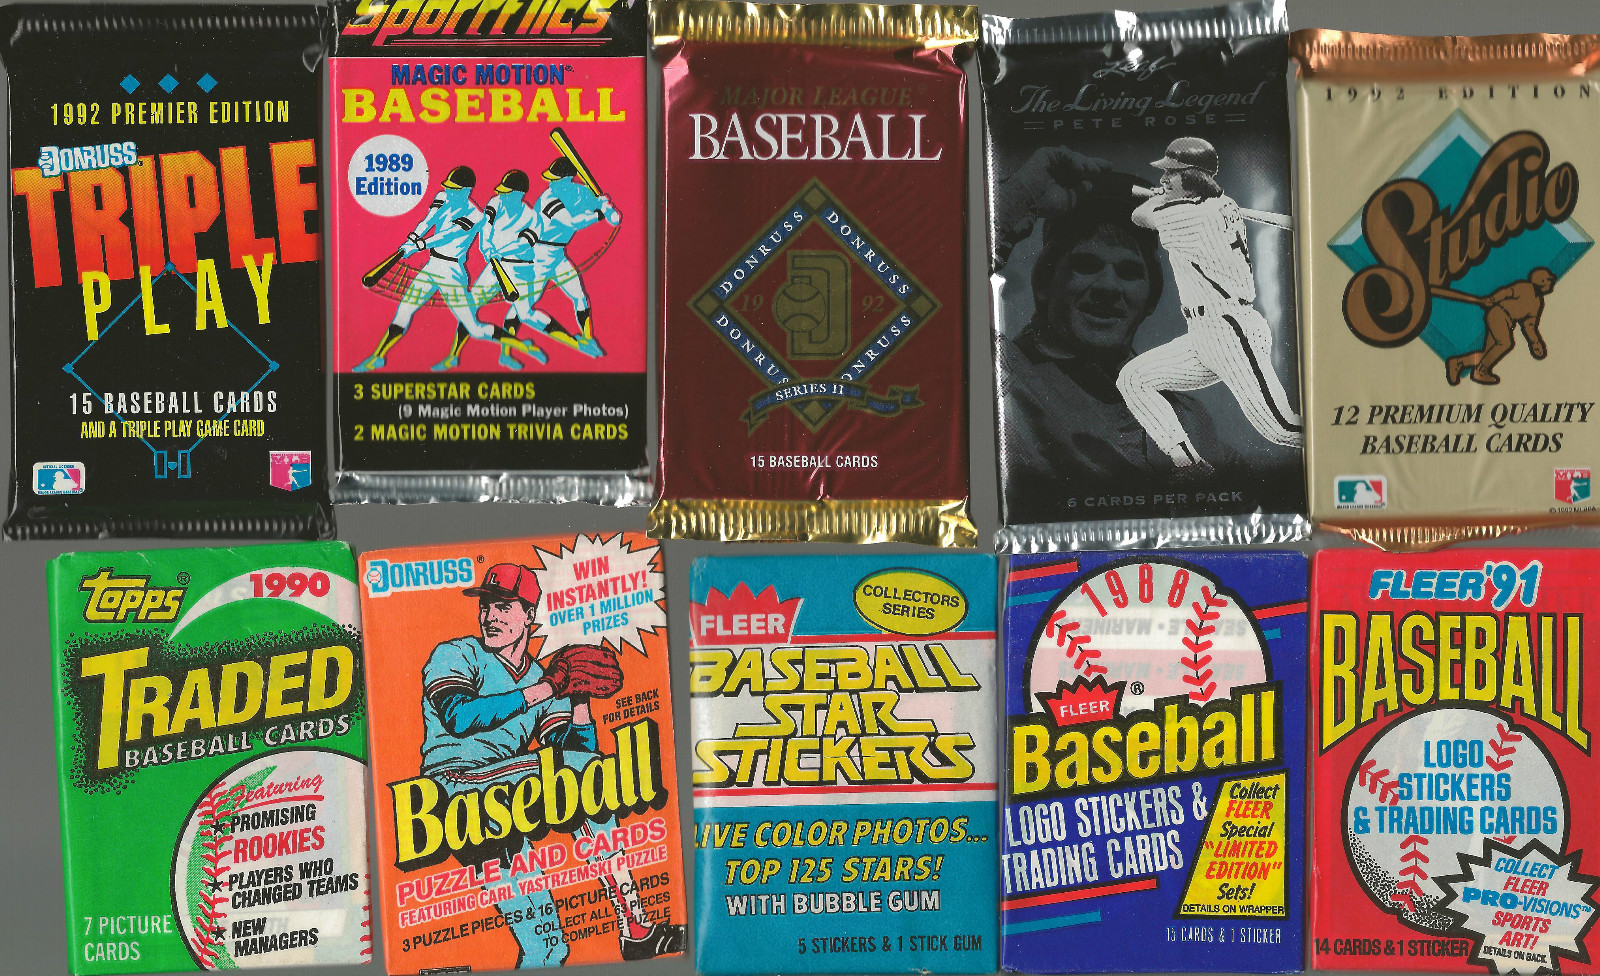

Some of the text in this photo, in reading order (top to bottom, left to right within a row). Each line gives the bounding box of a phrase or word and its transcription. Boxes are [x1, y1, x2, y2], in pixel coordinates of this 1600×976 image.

[391, 63, 467, 86] MAGIC
[341, 87, 626, 123] BASEBALL
[720, 85, 912, 108] MAJOR LEAGUE
[1011, 79, 1271, 118] The Living Legend
[1326, 84, 1592, 101] 1992 EDITION
[51, 100, 290, 126] 1992 PREMIER EDITION
[1053, 114, 1218, 130] PETE ROSE
[688, 112, 943, 161] BASEBALL
[365, 153, 414, 173] 1989
[355, 176, 422, 196] Edition
[11, 139, 321, 288] TRIPLE
[1343, 131, 1577, 347] Studio
[719, 211, 804, 296] DONRUSS
[826, 211, 910, 296] DONRUSS
[82, 253, 274, 341] PLAY
[69, 390, 278, 415] 15 BASEBALL CARDS
[371, 381, 536, 400] SUPERSTAR CARDS
[775, 383, 827, 401] SERIES
[418, 402, 629, 420] Magic Motion Player Photos)
[1331, 402, 1595, 428] 12 PREMIUM QUALITY
[80, 419, 265, 439] AND TRIPLE PLAY GAME CARD
[354, 422, 629, 441] 2 MAGIC MOTION TRIVIA CARDS
[1360, 432, 1564, 456] BASEBALL CARDS
[750, 455, 878, 468] 15 BASEBALL CARDS
[1084, 491, 1244, 507] CARDS PER PACK
[367, 557, 473, 593] DONRUSS
[573, 555, 610, 581] WIN
[250, 571, 331, 598] 1990
[546, 570, 647, 612] INSTANTLY!
[862, 584, 960, 608] COLLECTORS
[1081, 564, 1190, 617] 1988
[549, 589, 654, 628] OVER MILLION
[882, 602, 936, 621] SERIES
[583, 612, 629, 636] PRIZES
[701, 613, 786, 637] FLEER
[689, 645, 981, 697] BASEBALL
[1319, 611, 1591, 755] BASEBALL
[81, 646, 354, 770] TRADED
[615, 688, 659, 709] SEE BACK
[1060, 700, 1110, 718] FLEER
[603, 701, 660, 725] FOR DETAILS
[734, 691, 939, 737] STAR
[124, 714, 351, 769] BASEBALL CARDS
[1012, 690, 1275, 796] Baseball
[1424, 739, 1484, 769] LOGO
[693, 733, 976, 788] STICKERS
[388, 719, 664, 868] Baseball
[1229, 781, 1281, 800] Collect
[1398, 773, 1512, 802] STICKERS
[230, 803, 317, 833] PROMISING
[1005, 781, 1209, 847] LOGO STICKERS &
[1225, 800, 1275, 820] FLEER
[1353, 805, 1558, 835] & TRADING CARDS
[754, 818, 849, 848] COLOR
[852, 816, 988, 846] PHOTOS...
[1219, 820, 1275, 840] Special
[233, 825, 326, 864] ROOKIES
[228, 857, 334, 892] PLAYERS WHO
[397, 817, 668, 906] PUZZLE AND CARDS
[725, 853, 945, 885] TOP 125 STARS!
[1002, 830, 1184, 893] TRADING CARDS
[1494, 857, 1560, 880] COLLECT
[231, 872, 359, 910] CHANGED TEAMS
[400, 845, 668, 929] FEATURING CARL YASTRZEMSKI PUZZLE
[1217, 882, 1255, 901] Sets!
[1503, 876, 1550, 897] FLEER
[413, 872, 671, 949] PUZZLE PIECES PICTURE CARDS
[534, 892, 671, 936] COLLECT ALL PIECES
[725, 889, 941, 917] WITH BUBBLE GUM
[1183, 904, 1285, 914] DETAILS ON WRAPPER
[99, 914, 172, 934] PICTURE
[231, 917, 267, 939] NEW
[561, 921, 625, 944] COMPLETE
[1491, 910, 1552, 934] SPORTS
[234, 927, 319, 958] MANAGERS
[812, 934, 982, 954] STICKERS STICK GUM
[1181, 927, 1282, 944] CARDS STICKER
[1314, 938, 1469, 957] 14 CARDS STICKER
[1498, 930, 1540, 950] ART!
[84, 941, 140, 961] CARDS
[1482, 946, 1512, 959] DETAILS
